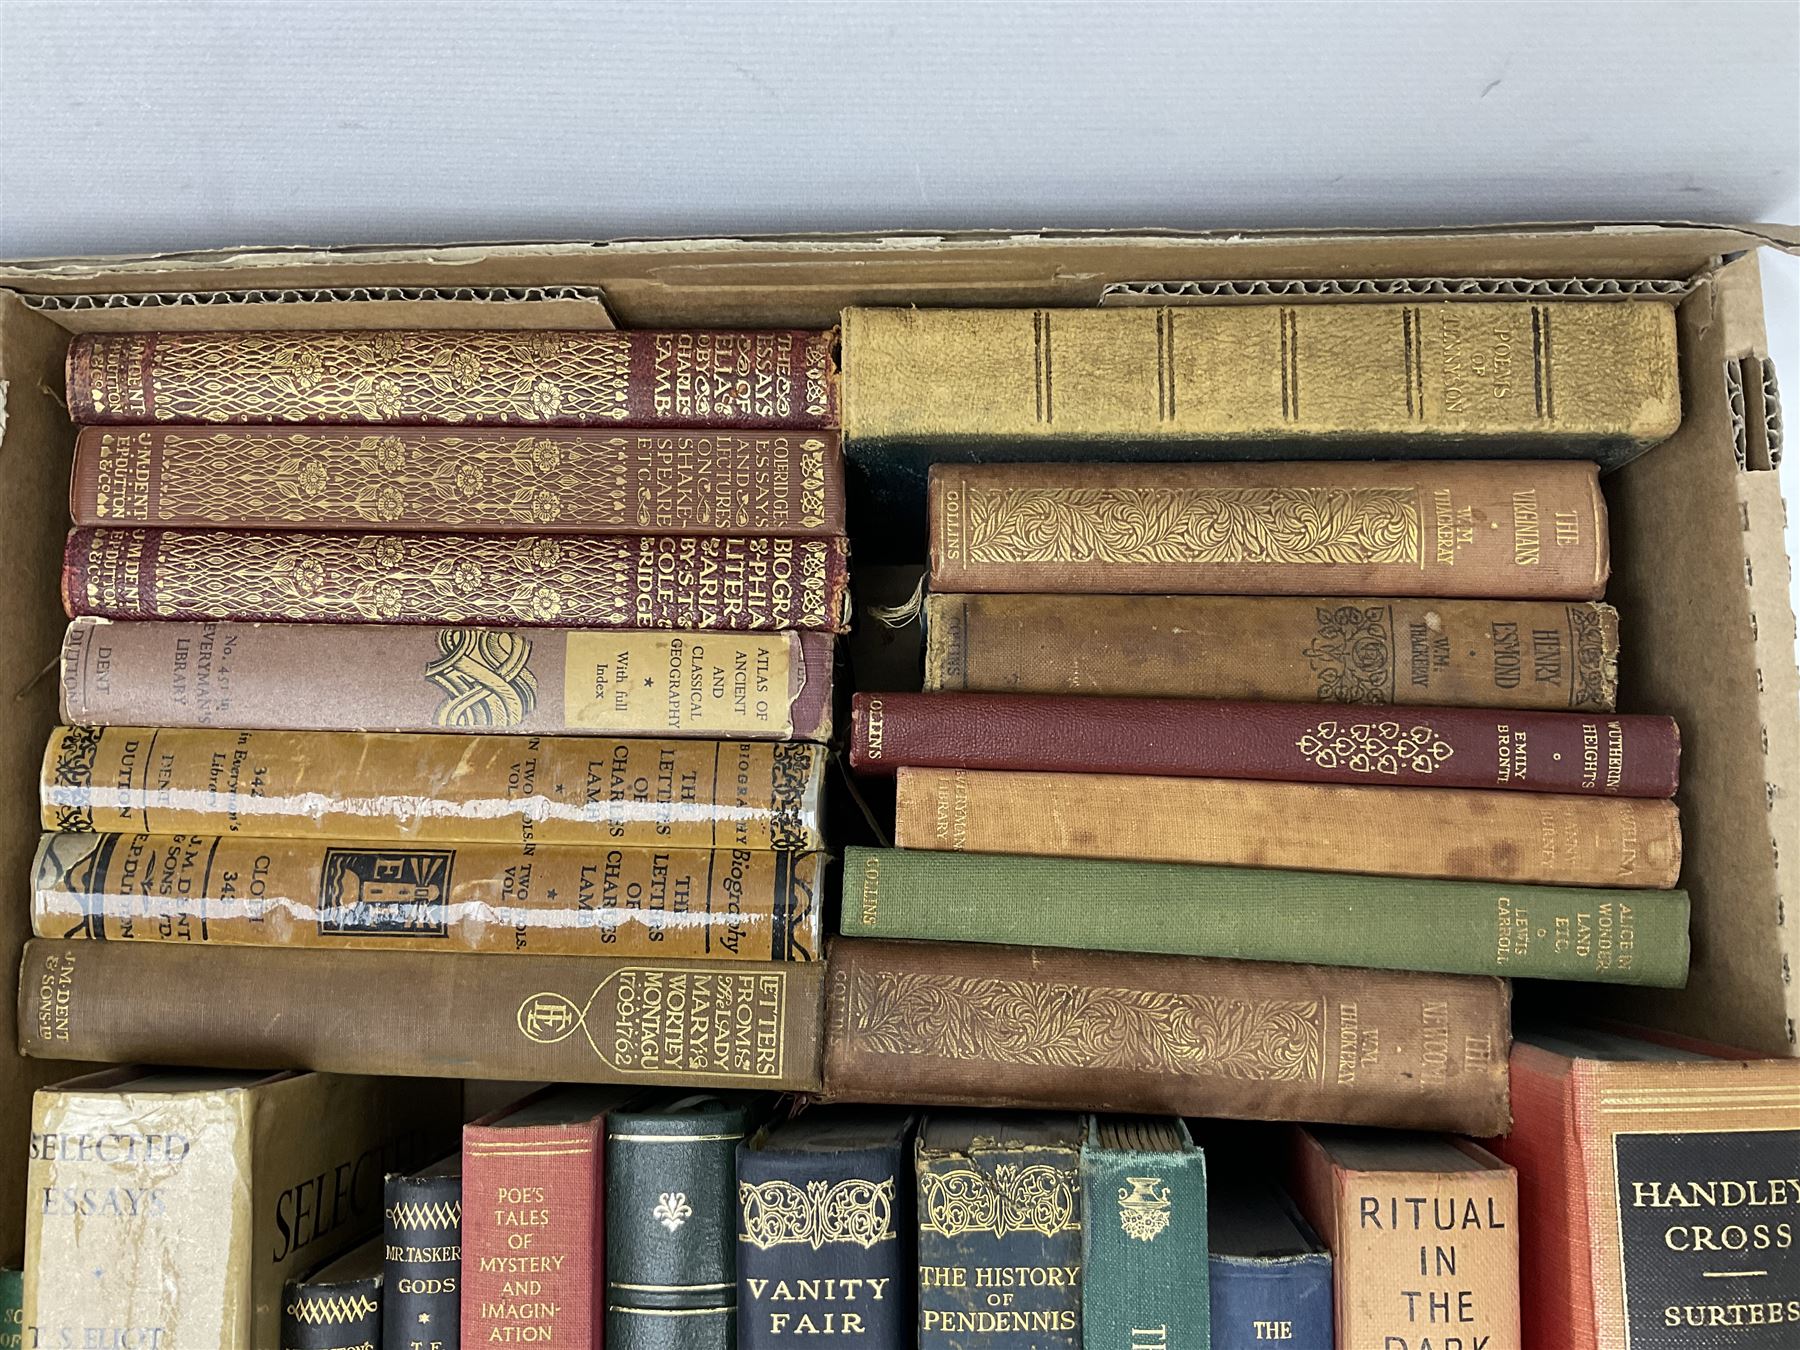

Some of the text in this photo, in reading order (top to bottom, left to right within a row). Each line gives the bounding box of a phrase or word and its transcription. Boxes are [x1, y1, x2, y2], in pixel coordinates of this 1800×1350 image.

[676, 335, 693, 416] CHARLES
[714, 336, 733, 398] ELIA
[755, 335, 774, 417] ESSAYS
[777, 336, 792, 376] THE
[1441, 314, 1462, 413] TENNYSON
[1471, 352, 1486, 376] OF
[1494, 329, 1511, 398] POEMS
[736, 380, 751, 413] OF
[638, 438, 652, 485] ETC.
[657, 438, 672, 526] SPEARE
[677, 438, 693, 527] SHAKE-
[697, 439, 712, 473] ON
[715, 437, 731, 527] LECTURES
[736, 439, 750, 486] AND
[755, 441, 770, 527] ESSAYS
[947, 491, 959, 560] COLLINS
[1434, 489, 1453, 566] THACKERAY
[1513, 488, 1540, 566] VIRGINIANS
[1555, 510, 1579, 546] THE
[636, 552, 653, 626] RIDGE
[772, 539, 792, 628] BIOGRA
[65, 630, 84, 703] DUTTON
[96, 647, 112, 694] DENT
[173, 638, 190, 704] LIBRARY
[198, 624, 216, 724] EVERYMAN'S
[222, 635, 237, 660] No.
[1410, 624, 1429, 689] THACKERAY
[1492, 621, 1520, 689] ESMOND
[1532, 630, 1561, 687] HENRY
[595, 664, 608, 698] Index
[616, 651, 629, 711] With full
[669, 638, 683, 728] GEOGRAPHY
[691, 646, 704, 721] CLASSICAL
[712, 667, 725, 698] AND
[734, 651, 746, 715] ANCIENT
[756, 648, 768, 721] ATLAS OF
[869, 700, 883, 759] OLLINS
[1514, 732, 1526, 780] EMILY
[1582, 723, 1598, 789] HEIGHTS
[118, 740, 139, 819] DUTTON
[158, 755, 175, 805] DENT
[208, 752, 225, 808] Library
[228, 732, 252, 832] in Everyman's
[522, 758, 536, 795] TWO
[586, 760, 603, 819] LAMB
[609, 745, 628, 837] CHARLES
[633, 776, 649, 809] OF
[655, 749, 675, 836] LETTERS
[681, 771, 697, 813] THE
[735, 743, 751, 846] BIOGRAPHY
[937, 777, 948, 840] LIBRARY
[159, 846, 180, 895] SONS
[518, 864, 532, 900] TWO
[578, 865, 597, 926] LAMB
[601, 850, 622, 944] CHARLES
[627, 882, 642, 909] OF
[649, 854, 669, 942] LETTERS
[674, 876, 690, 914] THE
[863, 856, 879, 925] COLLINS
[720, 850, 751, 954] Biography
[1497, 897, 1510, 964] CARROLL
[1514, 908, 1528, 956] LEWIS
[1576, 912, 1591, 957] LAND
[1618, 903, 1633, 971] ALICE IN
[46, 955, 58, 971] &
[615, 972, 638, 1065] 1709-1762
[640, 971, 663, 1070] MONTAGU
[664, 974, 686, 1070] WORTLEY
[689, 975, 712, 1057] MARY
[735, 975, 755, 1047] FROM
[756, 975, 779, 1075] LETTERS
[830, 970, 847, 1047] COLLINS
[714, 1010, 731, 1071] LADY
[1338, 1002, 1357, 1087] THACKERAY
[1465, 1035, 1491, 1072] THE
[29, 1133, 190, 1161] SELECTED
[41, 1187, 168, 1216] ESSAYS
[494, 1210, 549, 1226] TALES
[498, 1188, 544, 1204] POE'S
[1360, 1196, 1505, 1230] RITUAL
[1632, 1179, 1800, 1207] HANDLEY
[480, 1256, 564, 1273] MYSTERY
[508, 1234, 532, 1250] OF
[1420, 1246, 1456, 1276] IN
[1665, 1224, 1792, 1251] CROSS
[399, 1278, 456, 1293] GODS
[502, 1281, 541, 1296] AND
[747, 1278, 890, 1301] VANITY
[920, 1266, 1081, 1287] THE HISTORY
[987, 1293, 1014, 1307] OF
[481, 1303, 561, 1319] IMAGIN-
[489, 1326, 552, 1342] ATION
[770, 1313, 865, 1334] FAIR
[923, 1310, 1076, 1332] PENDENNIS
[1254, 1321, 1292, 1340] THE
[1401, 1291, 1474, 1323] THE
[1665, 1301, 1800, 1326] SURTEES
[84, 1327, 164, 1350] ELIOT
